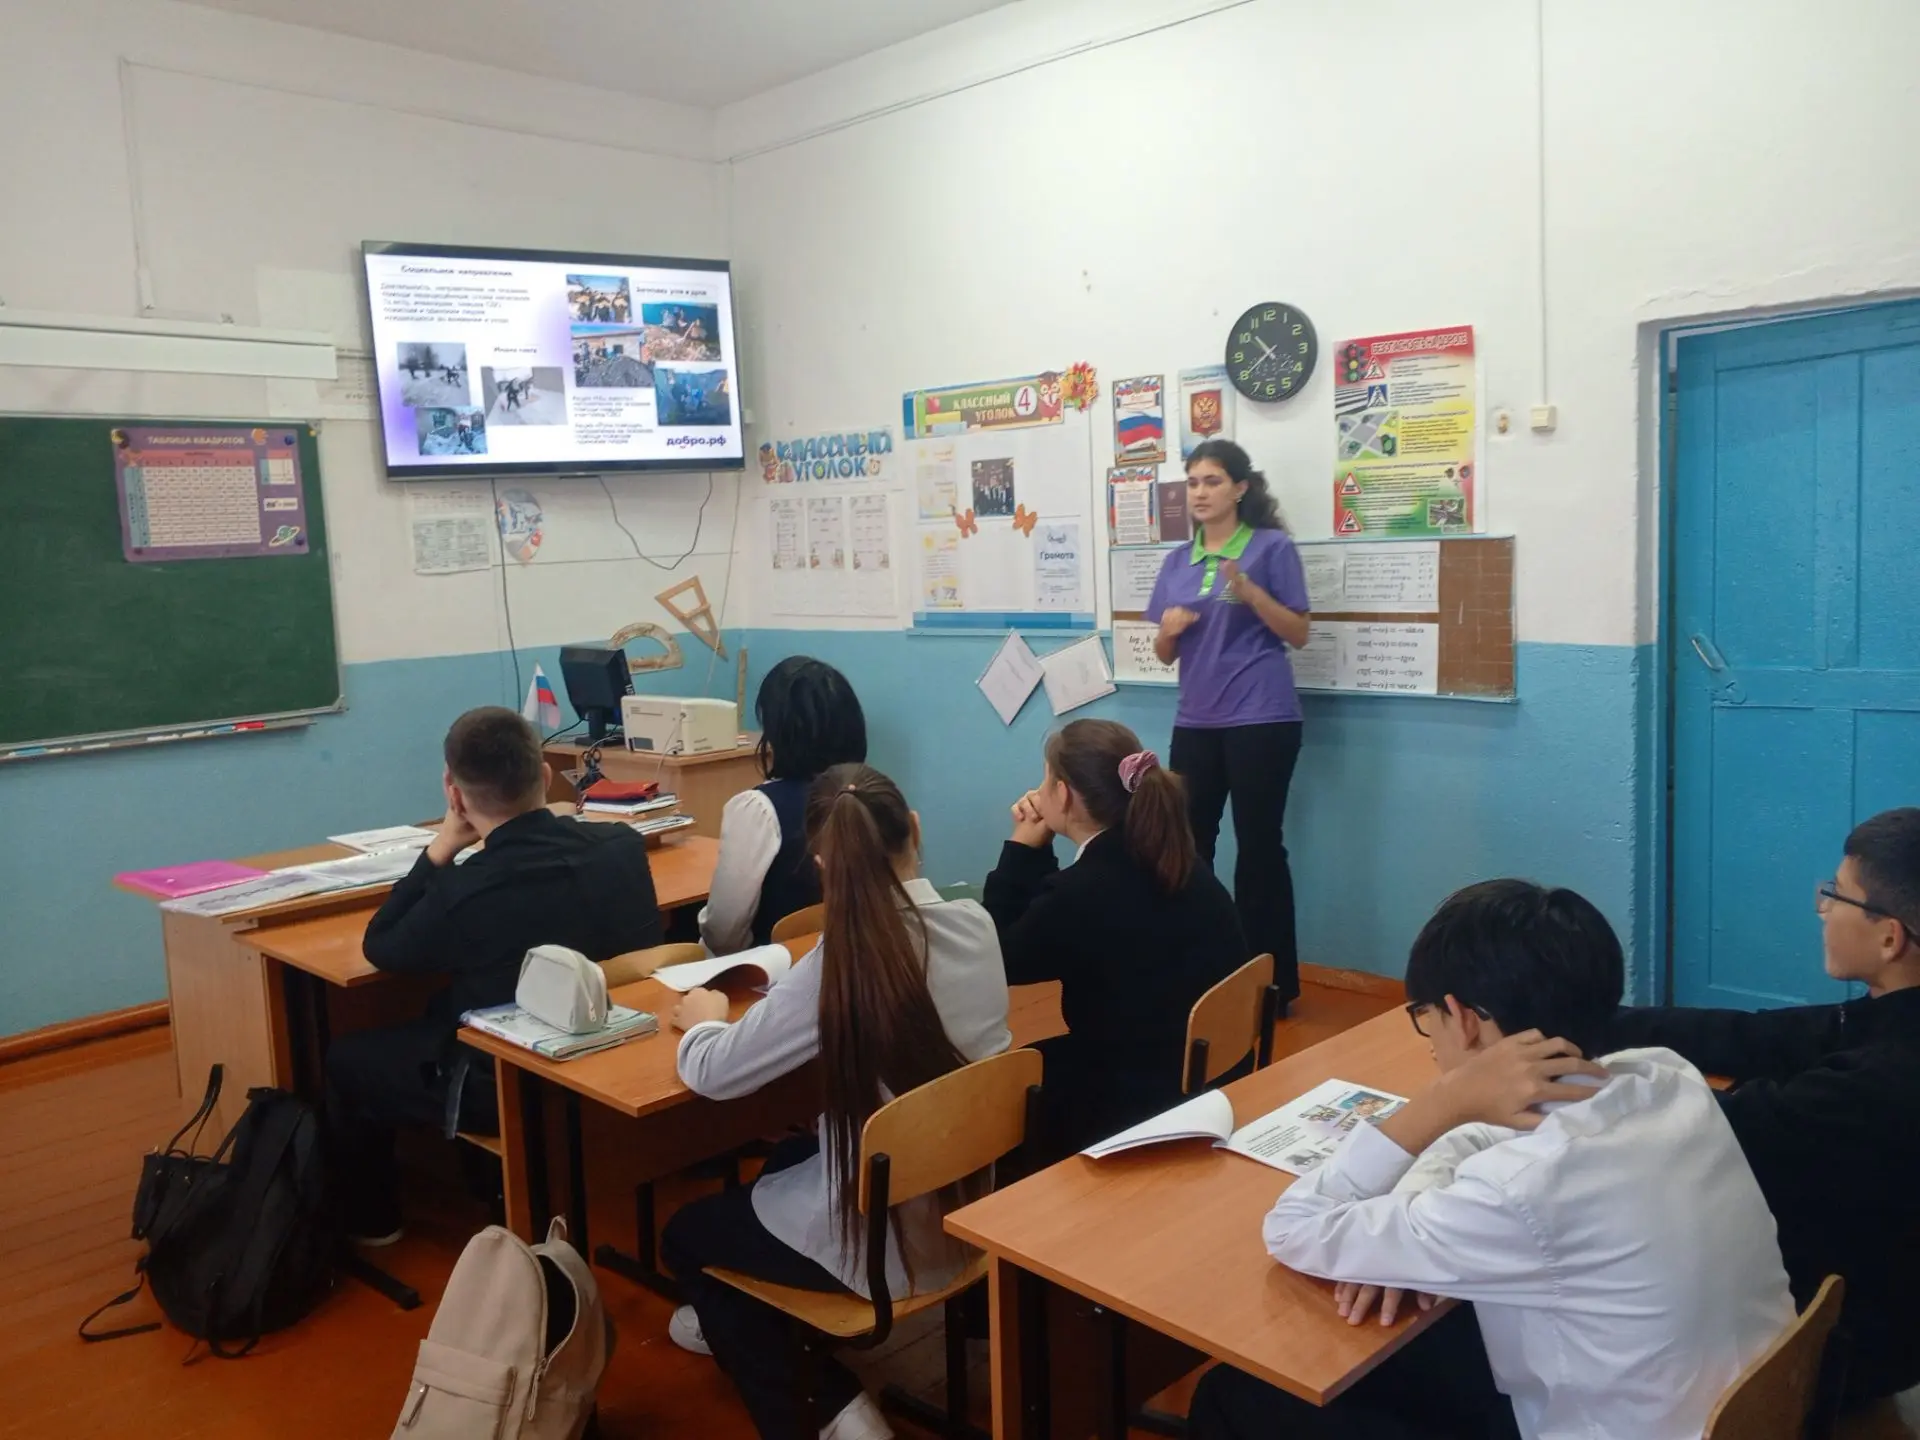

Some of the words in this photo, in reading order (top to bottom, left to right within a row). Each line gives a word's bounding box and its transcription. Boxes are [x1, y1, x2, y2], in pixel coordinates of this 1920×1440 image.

[1251, 317, 1259, 330] 11
[1283, 312, 1288, 324] 1
[1264, 309, 1276, 321] 12
[1239, 332, 1251, 344] 10
[1292, 323, 1303, 336] 2
[1234, 352, 1244, 364] 9
[1299, 342, 1308, 354] 3
[1239, 370, 1250, 382] 8
[1293, 361, 1303, 372] 4
[1250, 381, 1261, 396] 7
[1266, 383, 1276, 396] 6
[1281, 377, 1292, 389] 5
[953, 392, 1011, 411] КЛАССНЫЙ
[1017, 385, 1031, 412] 4
[975, 407, 1016, 423] УГОЛОК
[148, 435, 191, 445] ТАБЛИЦА
[666, 435, 727, 450] добро.рф
[794, 457, 867, 482] УГОЛОК
[1040, 551, 1075, 561] Грамота
